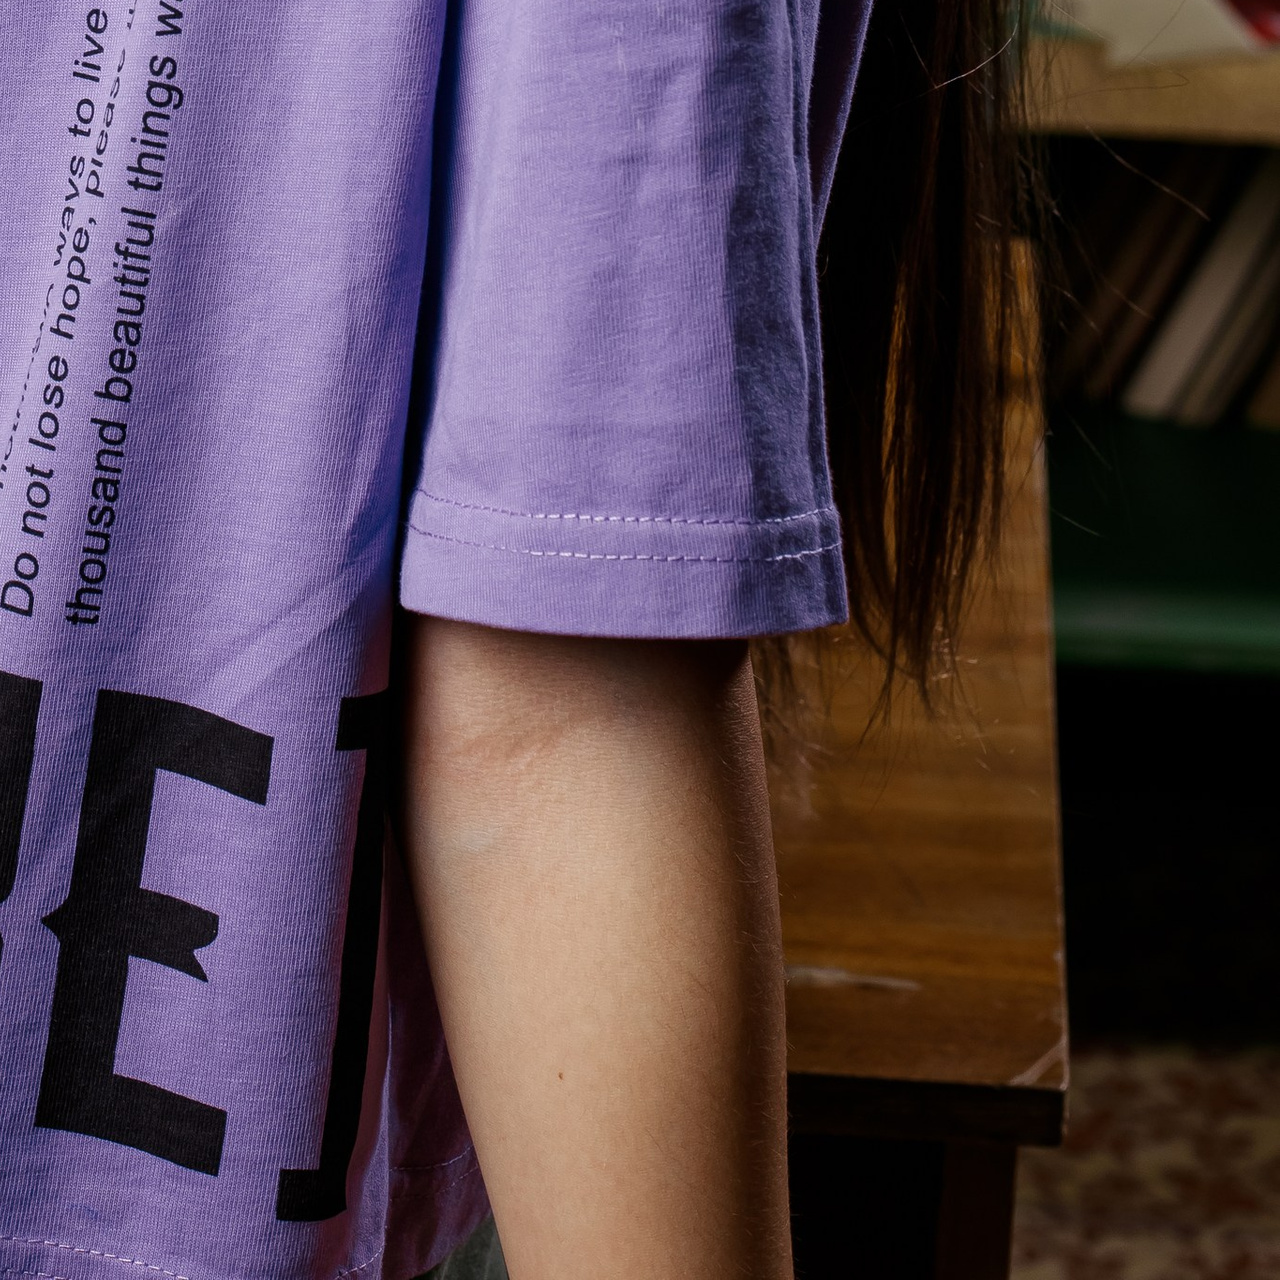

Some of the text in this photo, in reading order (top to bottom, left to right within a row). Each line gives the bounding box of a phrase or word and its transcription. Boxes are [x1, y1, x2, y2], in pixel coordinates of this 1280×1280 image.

[72, 8, 108, 83] live
[67, 98, 94, 137] to
[127, 55, 184, 191] things
[50, 217, 97, 340] hope,
[94, 207, 157, 403] beautiful
[28, 355, 68, 451] lose
[21, 463, 54, 538] not
[65, 417, 128, 625] thousand
[0, 552, 39, 617] Do
